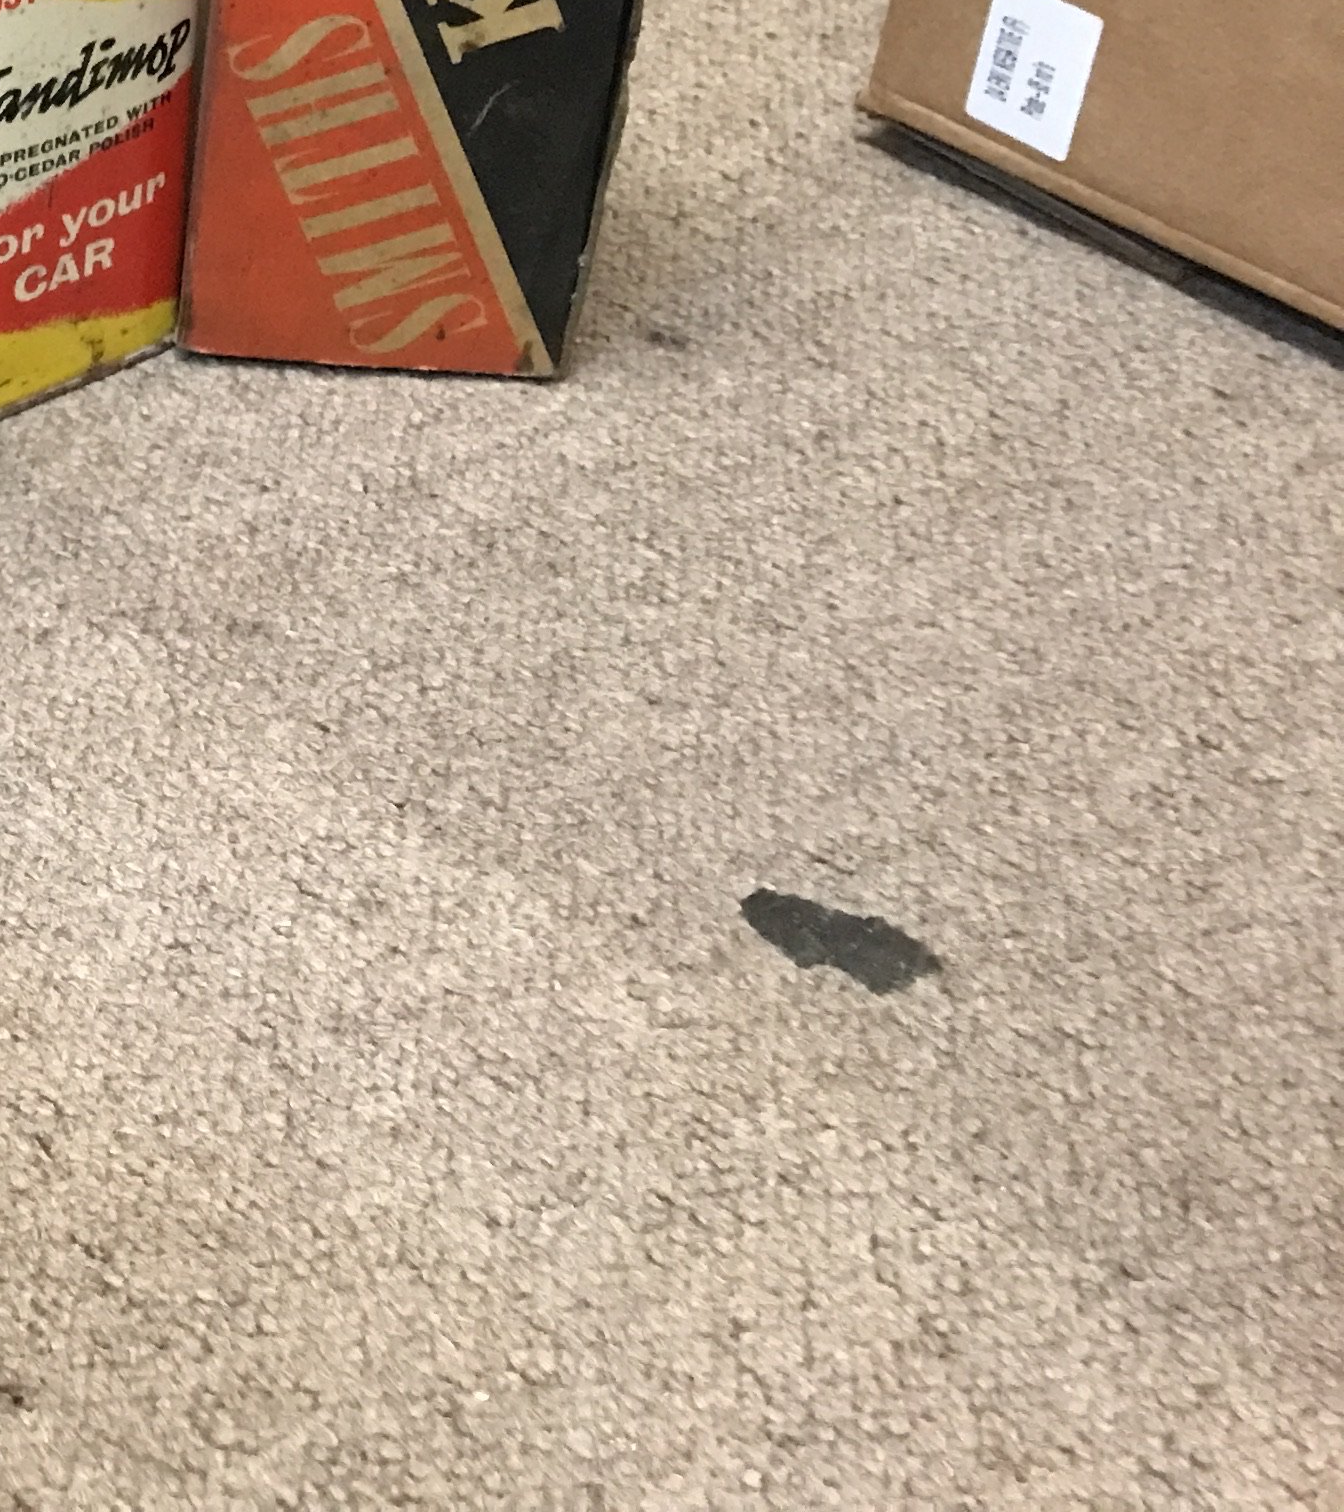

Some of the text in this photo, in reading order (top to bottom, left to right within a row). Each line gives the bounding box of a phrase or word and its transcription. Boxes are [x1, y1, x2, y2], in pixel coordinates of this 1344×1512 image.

[88, 117, 155, 158] POLISH
[126, 90, 172, 121] WITH
[59, 171, 167, 248] your
[228, 13, 490, 356] SMITHS
[13, 237, 116, 303] CAR
